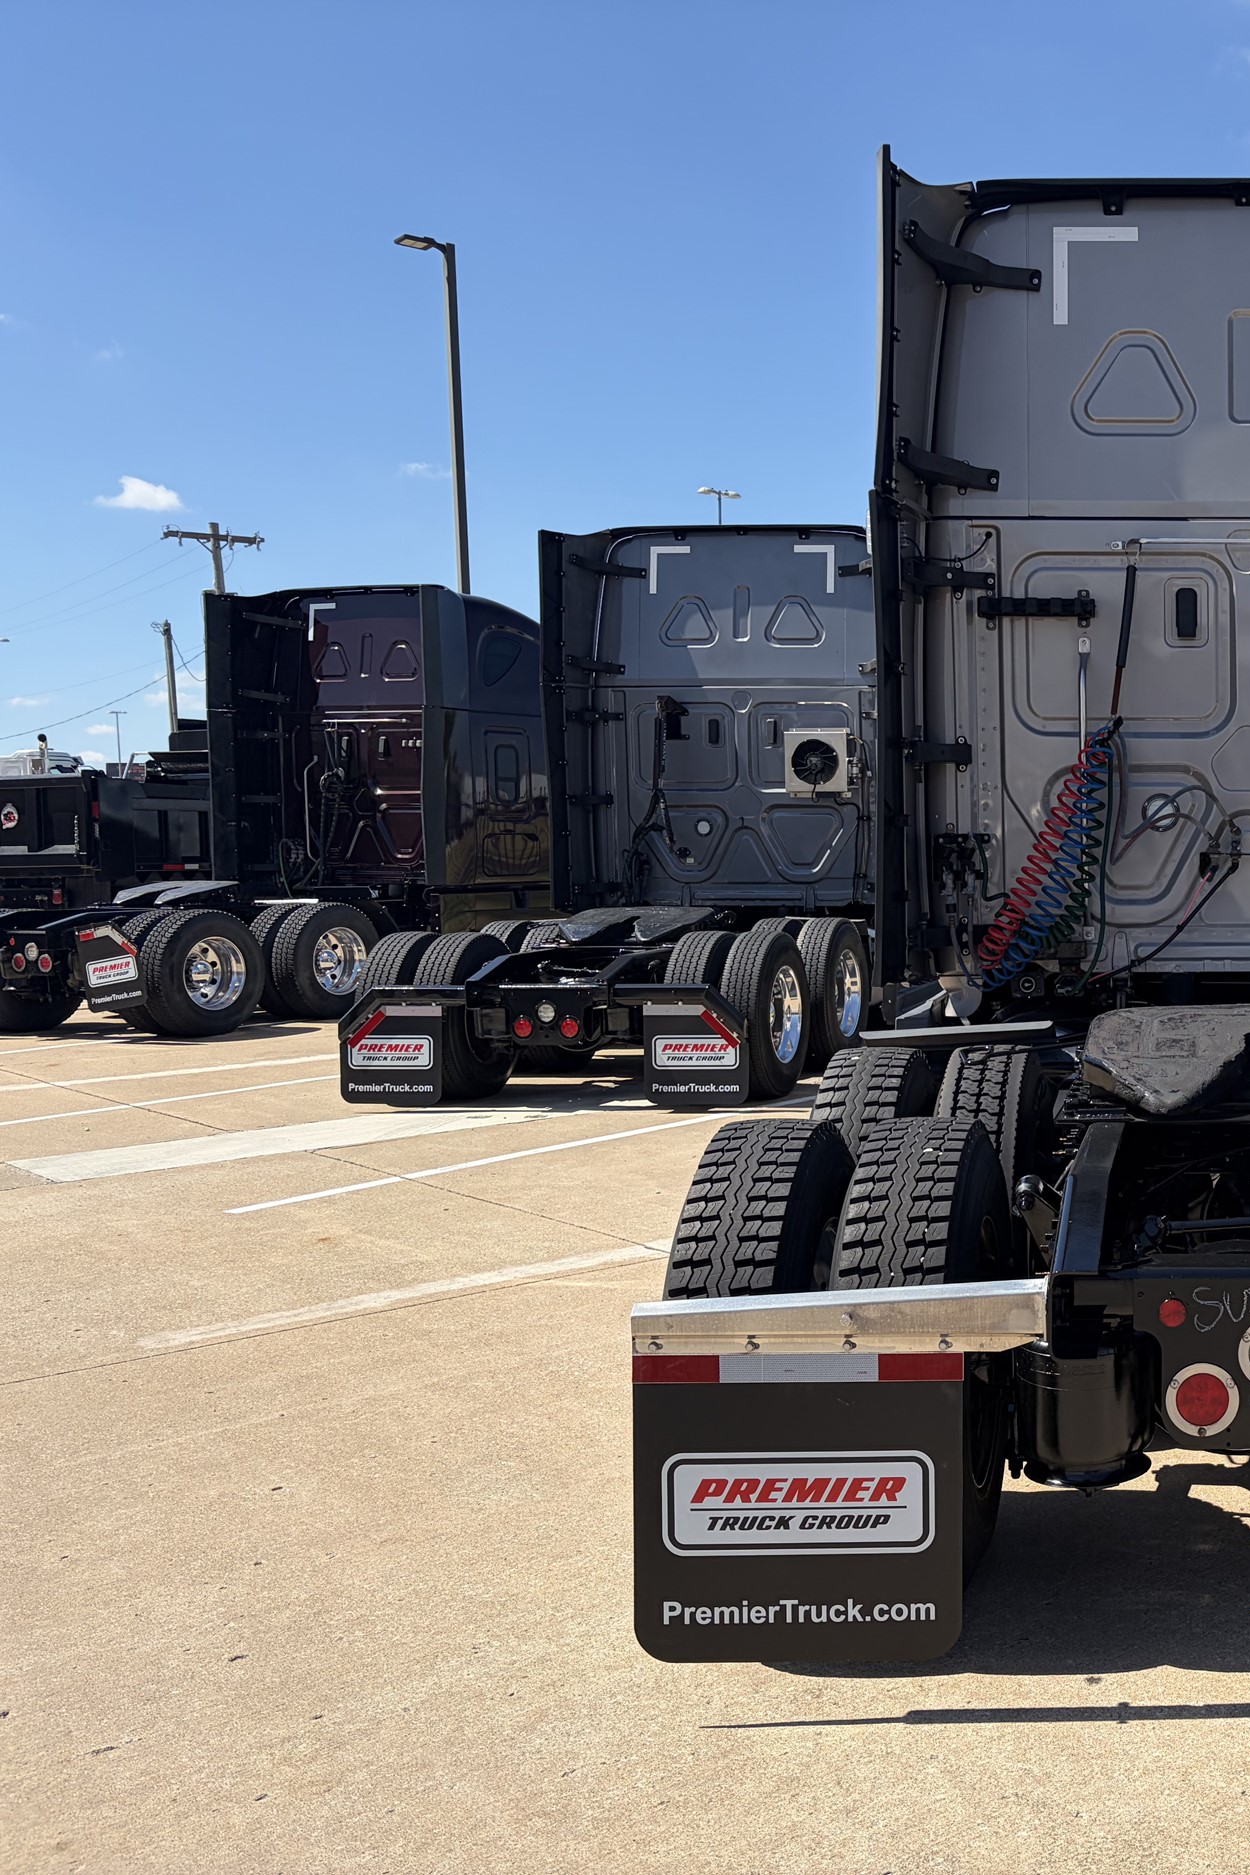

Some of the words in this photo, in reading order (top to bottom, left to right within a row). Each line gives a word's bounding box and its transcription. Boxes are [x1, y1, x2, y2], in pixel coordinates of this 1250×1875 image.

[92, 961, 131, 974] PREMIER
[91, 990, 142, 1005] PremierTruck.com
[357, 1043, 424, 1052] PREMIER
[661, 1043, 730, 1052] PREMIER
[348, 1082, 433, 1092] PremierTruck.com
[652, 1083, 739, 1092] PremierTruck.com
[690, 1476, 907, 1504] PREMIER
[706, 1515, 796, 1531] TRUCK
[799, 1514, 891, 1530] GROUP
[663, 1598, 936, 1625] PremierTruck.com
